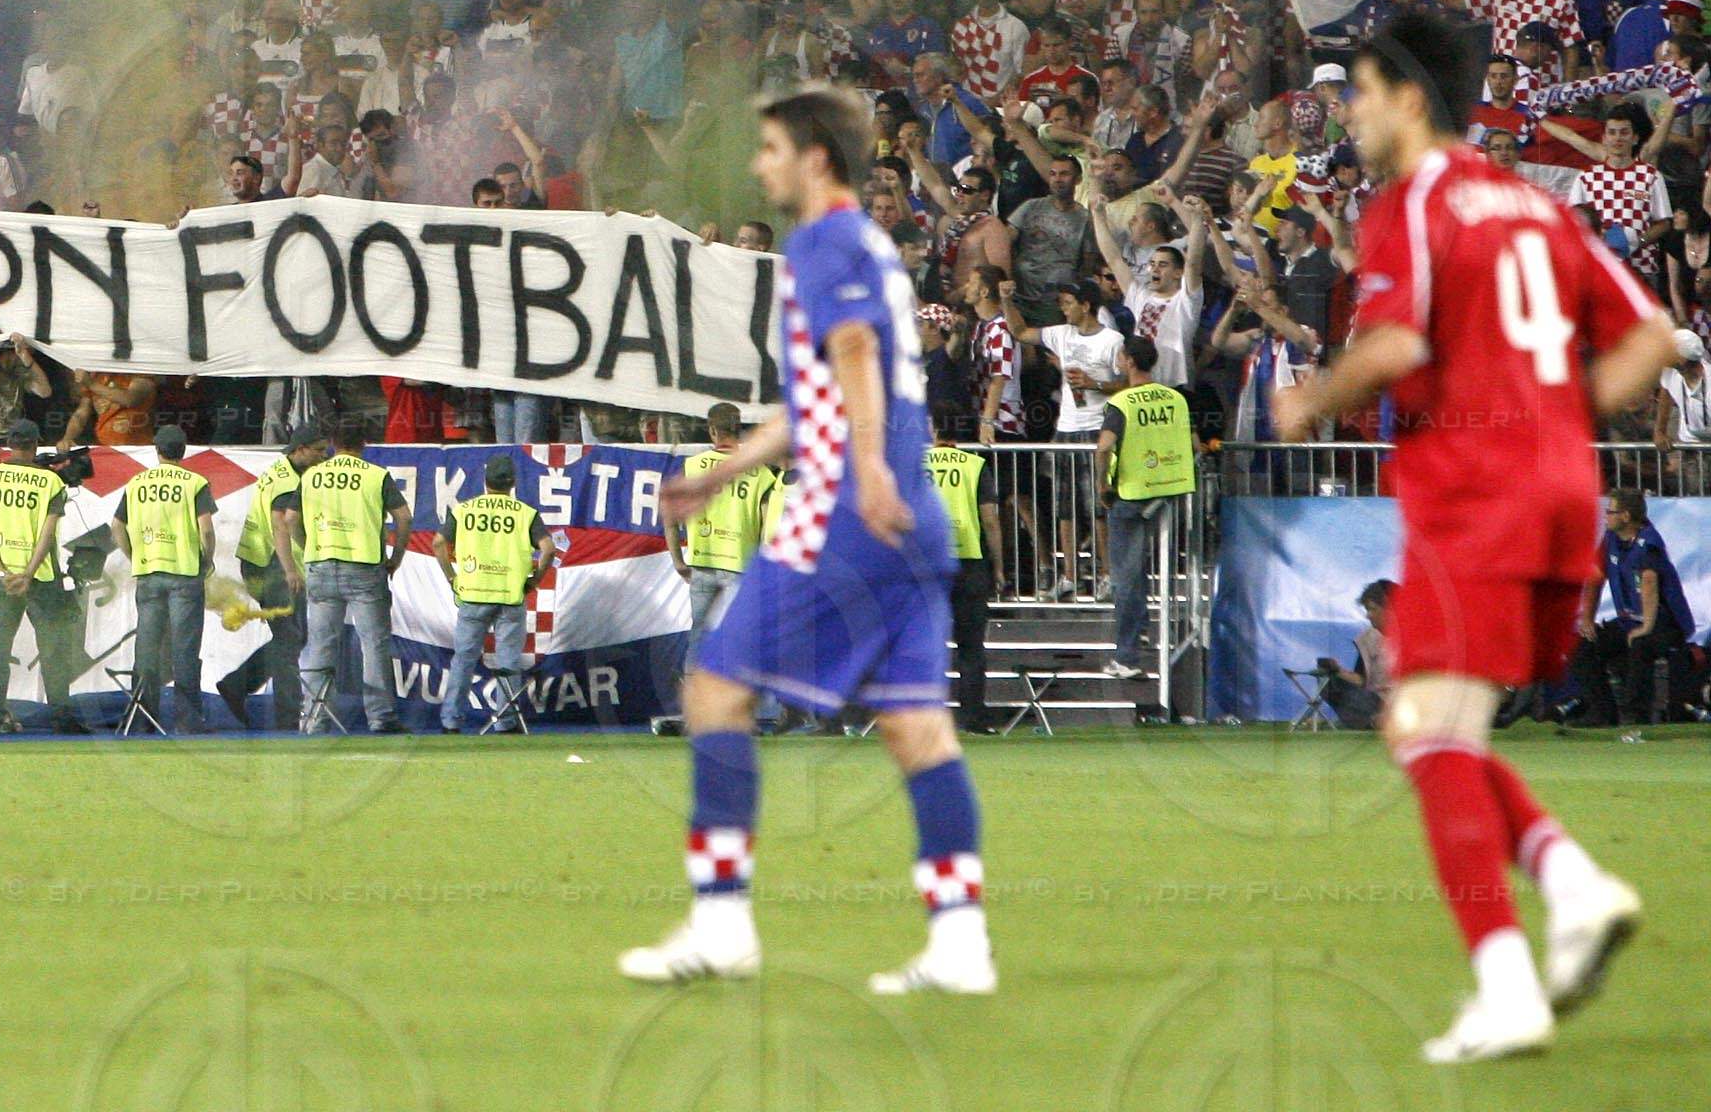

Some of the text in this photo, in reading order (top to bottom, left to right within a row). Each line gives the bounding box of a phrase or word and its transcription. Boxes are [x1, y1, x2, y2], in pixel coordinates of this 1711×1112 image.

[1495, 229, 1576, 386] 4
[1126, 388, 1176, 405] STEWARD
[1137, 405, 1175, 427] 0447
[311, 471, 362, 491] 0398
[137, 484, 183, 504] 0368
[461, 498, 522, 513] STEWARD
[463, 513, 516, 535] 0369
